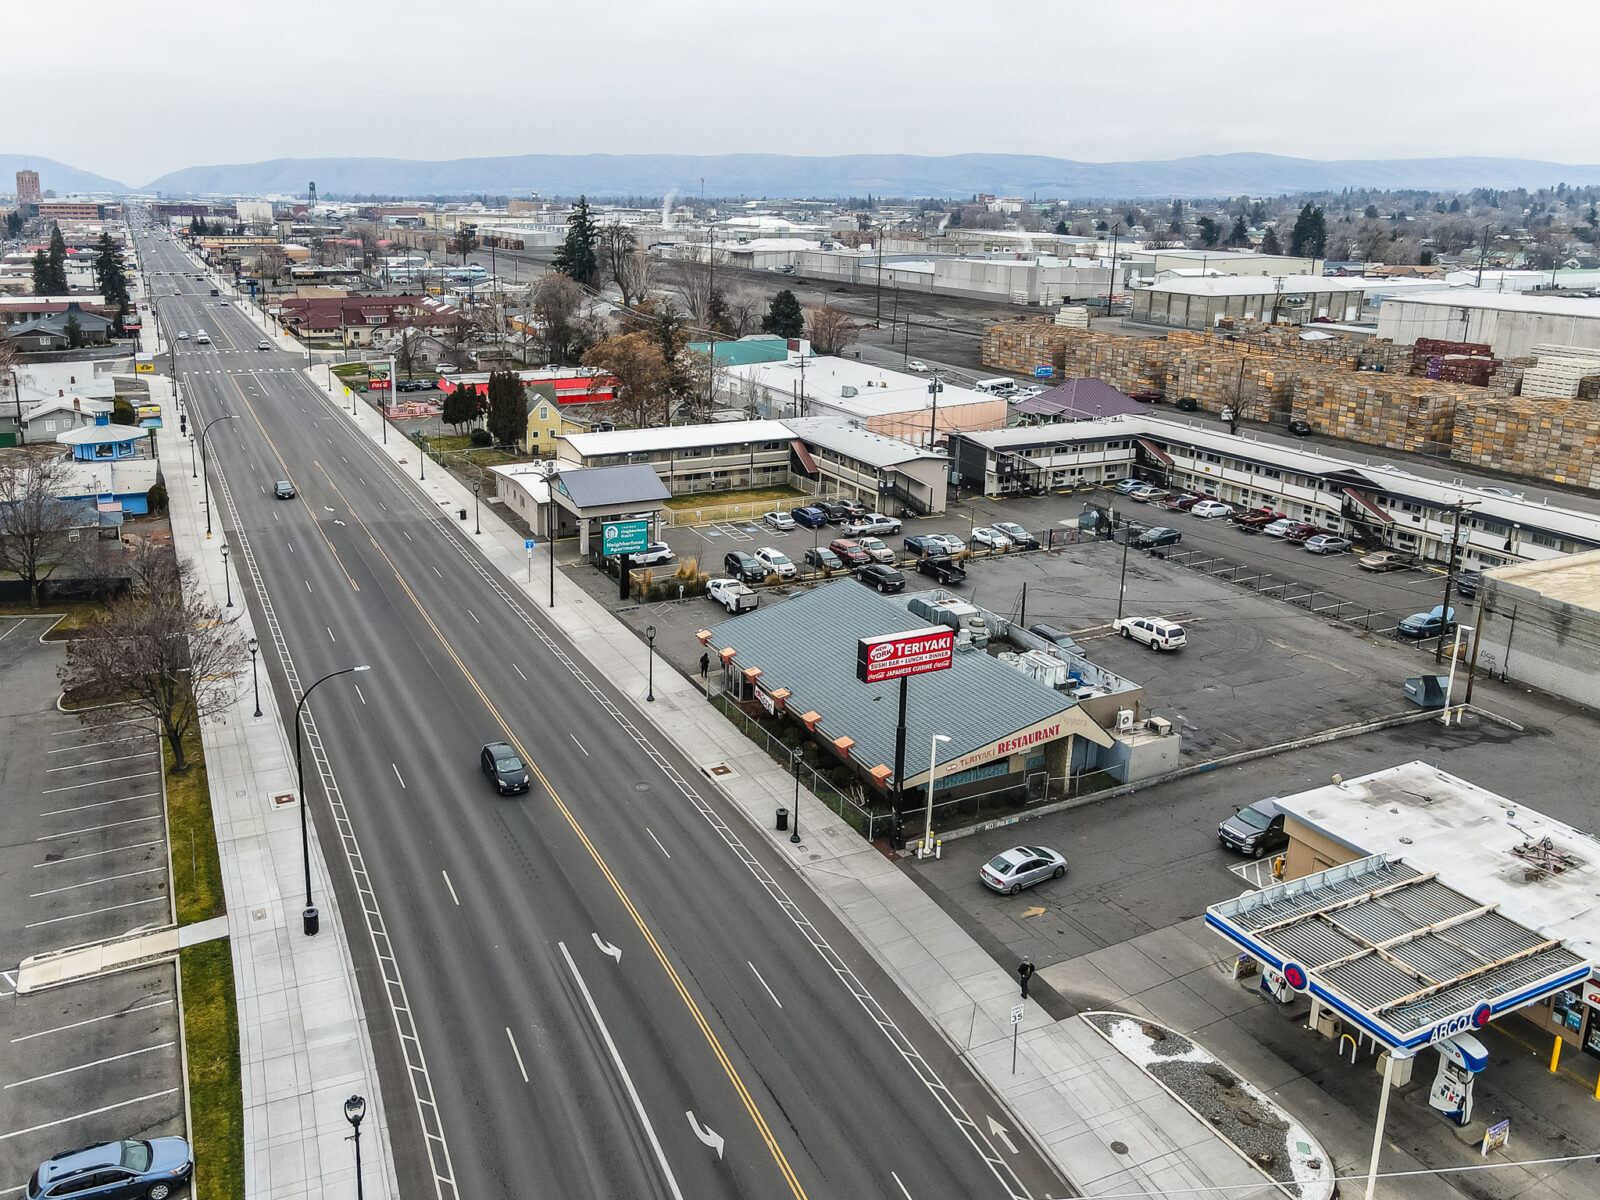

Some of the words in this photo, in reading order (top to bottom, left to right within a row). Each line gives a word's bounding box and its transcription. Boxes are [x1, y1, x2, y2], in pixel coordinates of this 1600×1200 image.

[607, 540, 644, 548] Neighborhood
[896, 637, 950, 656] TERIYAKI
[871, 649, 892, 660] YORK
[928, 650, 948, 659] DINNER
[886, 667, 912, 677] JAPANESE
[912, 663, 932, 672] CUISINE
[960, 749, 996, 766] TERIYAKI
[997, 724, 1060, 754] RESTAURANT
[985, 823, 994, 831] NO
[1012, 1012, 1022, 1022] 35
[1429, 1016, 1467, 1044] ARCO
